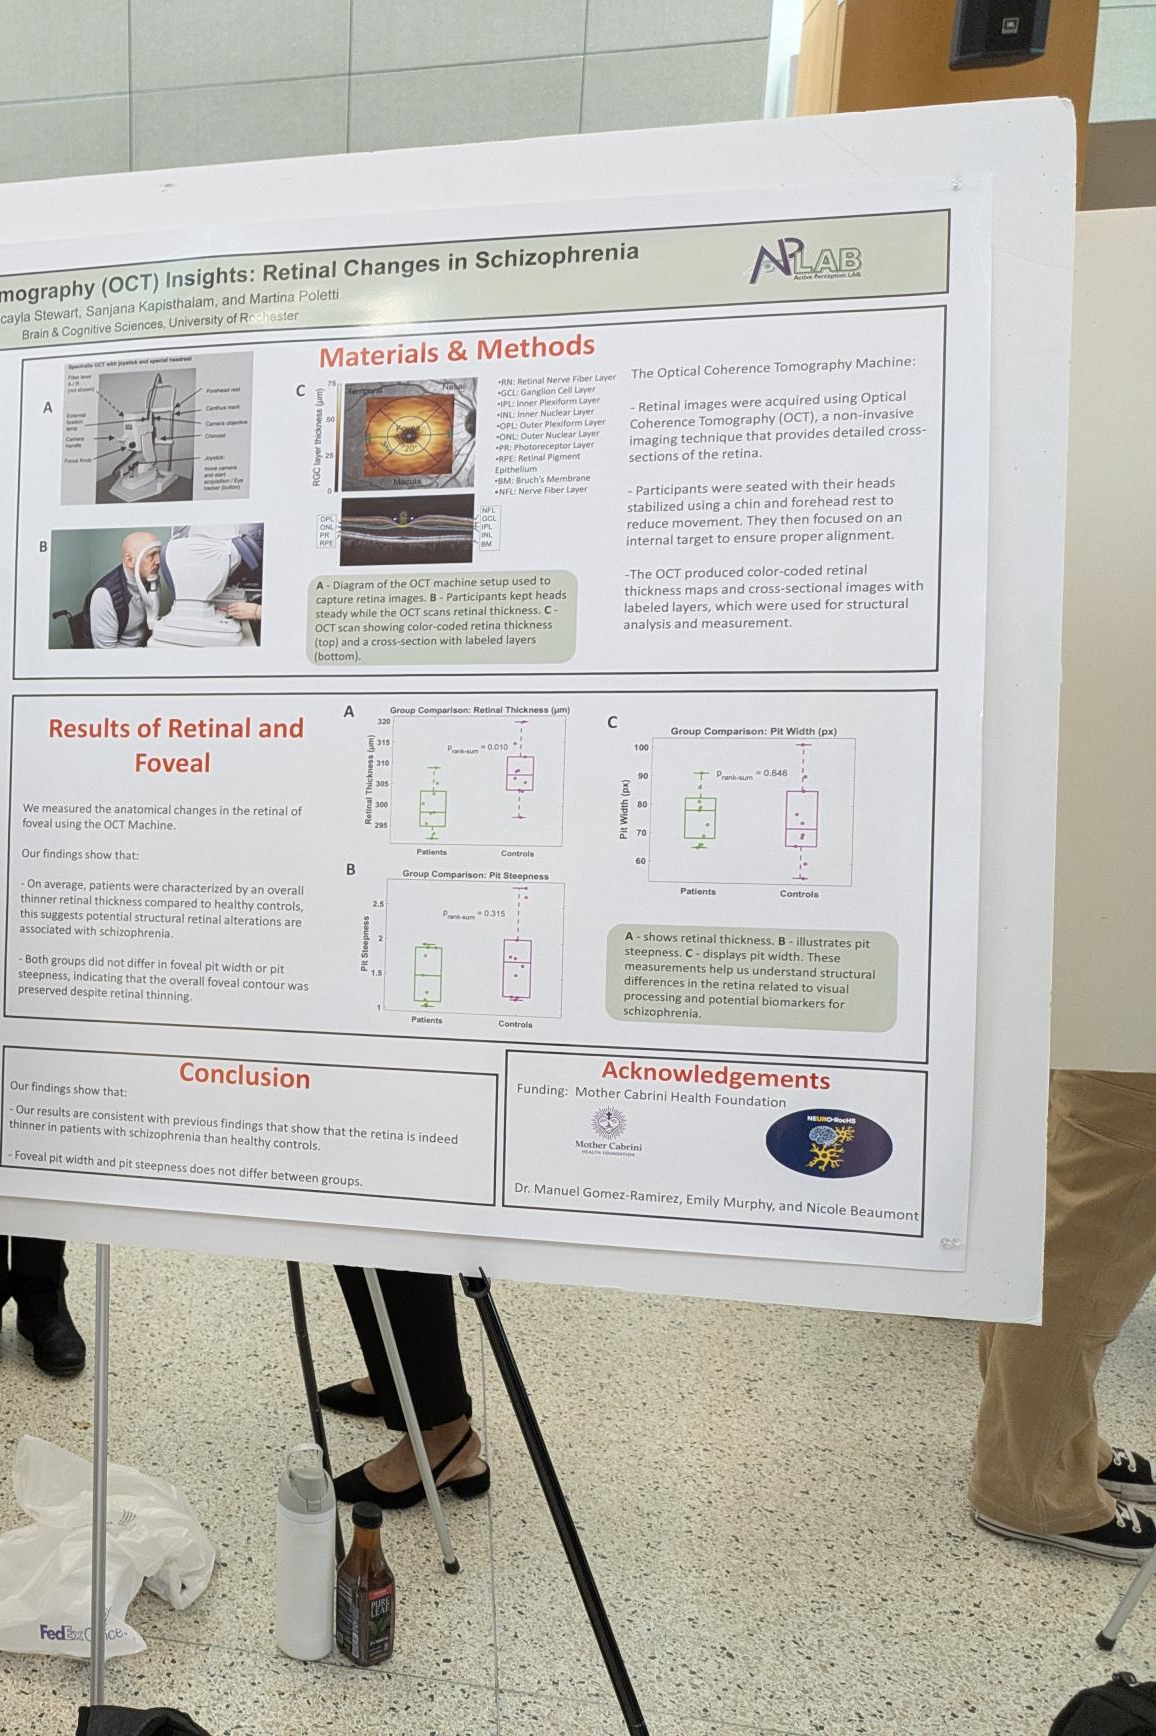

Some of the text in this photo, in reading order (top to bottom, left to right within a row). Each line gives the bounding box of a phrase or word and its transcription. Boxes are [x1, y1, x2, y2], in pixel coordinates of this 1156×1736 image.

[101, 273, 158, 298] (OCT)
[166, 267, 254, 289] Insights:
[263, 260, 336, 281] Retinal
[343, 258, 439, 277] Changes
[448, 252, 467, 270] in
[475, 242, 638, 268] Schizophrenia
[34, 307, 81, 321] Stewart,
[85, 303, 135, 318] Sanjana
[138, 296, 217, 313] Kapisthalam,
[221, 292, 245, 305] and
[249, 291, 294, 304] Martina
[298, 287, 339, 301] Poletti
[320, 333, 594, 368] Materials & Methods
[630, 356, 915, 379] The Optical Coherence Tomography Machine:
[517, 376, 544, 385] Retinal
[572, 374, 593, 382] Fiber
[594, 374, 616, 382] Layer
[296, 384, 305, 396] C
[42, 401, 52, 413] A
[39, 540, 47, 552] B
[49, 716, 303, 738] Results of Retinal and
[607, 715, 617, 728] C
[671, 727, 838, 737] Group Comparison: Pit Width (px)
[634, 743, 649, 751] 100
[135, 751, 209, 772] Foveal
[763, 769, 788, 777] 0.646
[680, 887, 716, 895] Patients
[779, 889, 819, 898] Controls
[19, 924, 173, 939] associated with schizophrenia.
[179, 1061, 311, 1090] Conclusion
[601, 1060, 831, 1091] Acknowledgements
[517, 1083, 786, 1108] Funding: Mother Cabrini Health Foundation
[575, 1140, 642, 1151] Mother Cabrini
[514, 1182, 920, 1223] Dr. Manuel Gomez-Ramirez, Emily Murphy, and Nicole Beaumont
[39, 1624, 84, 1641] FedEx
